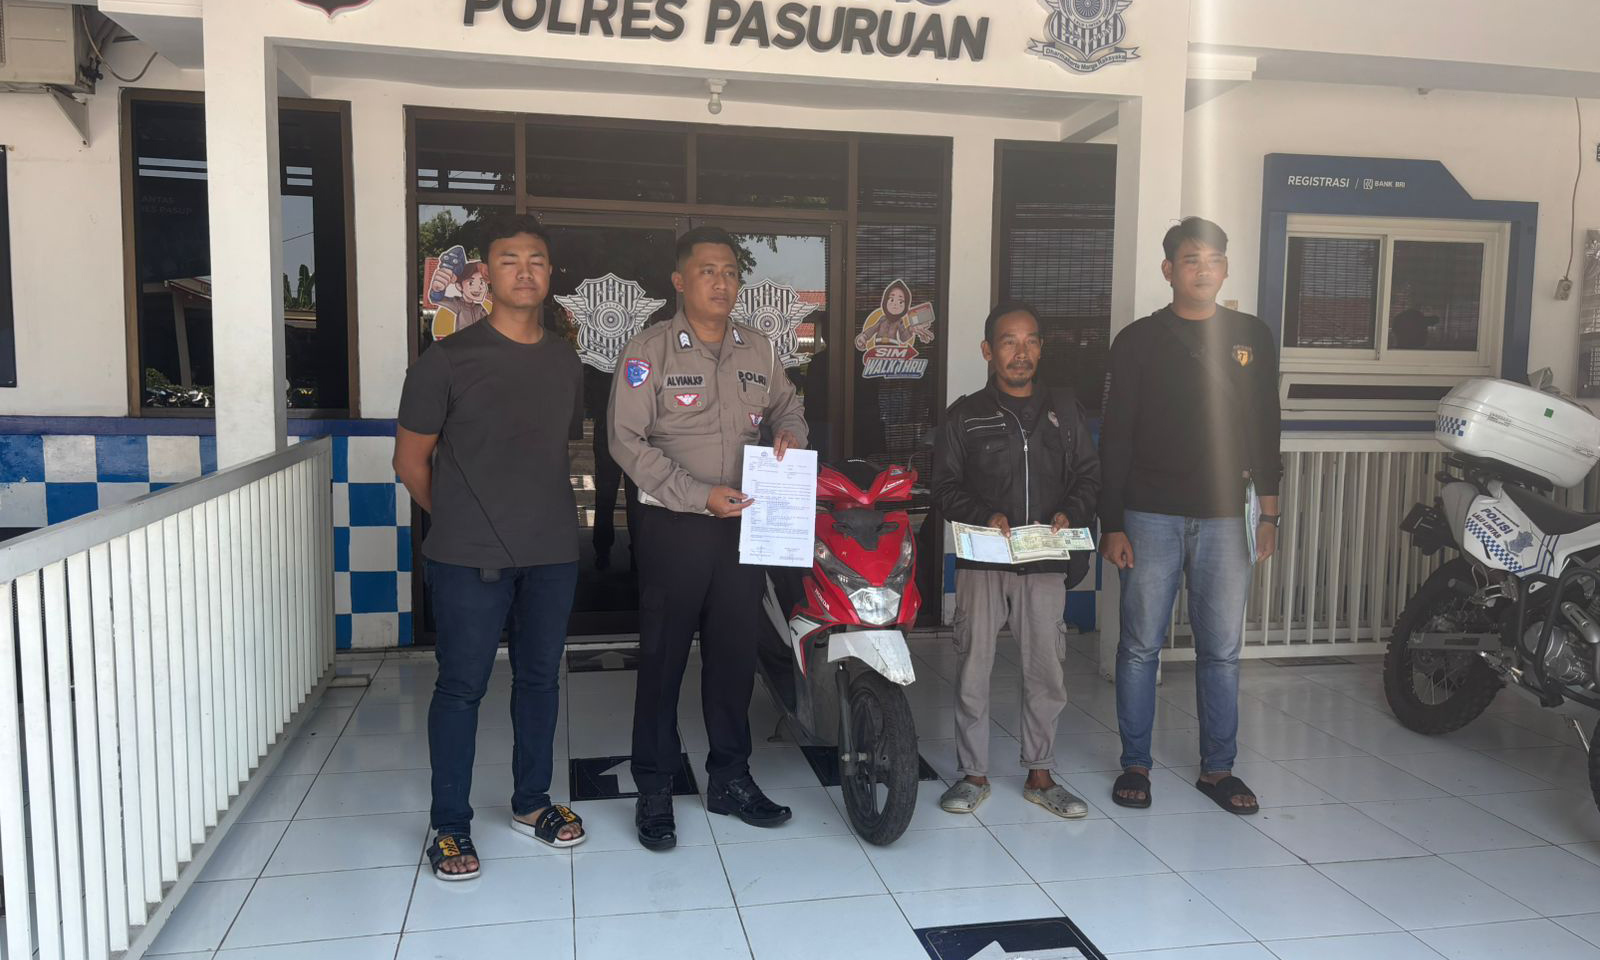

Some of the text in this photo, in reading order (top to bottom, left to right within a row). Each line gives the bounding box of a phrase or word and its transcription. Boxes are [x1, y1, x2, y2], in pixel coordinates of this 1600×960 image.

[463, 0, 990, 62] POLRES PASURUAN
[1287, 175, 1350, 188] REGISTRASI
[1374, 180, 1393, 188] BANK
[875, 348, 908, 358] SIM
[864, 359, 927, 375] WALK THRU
[738, 371, 767, 387] POLRI
[1480, 508, 1514, 535] POLISI
[1482, 521, 1502, 539] LINTAS
